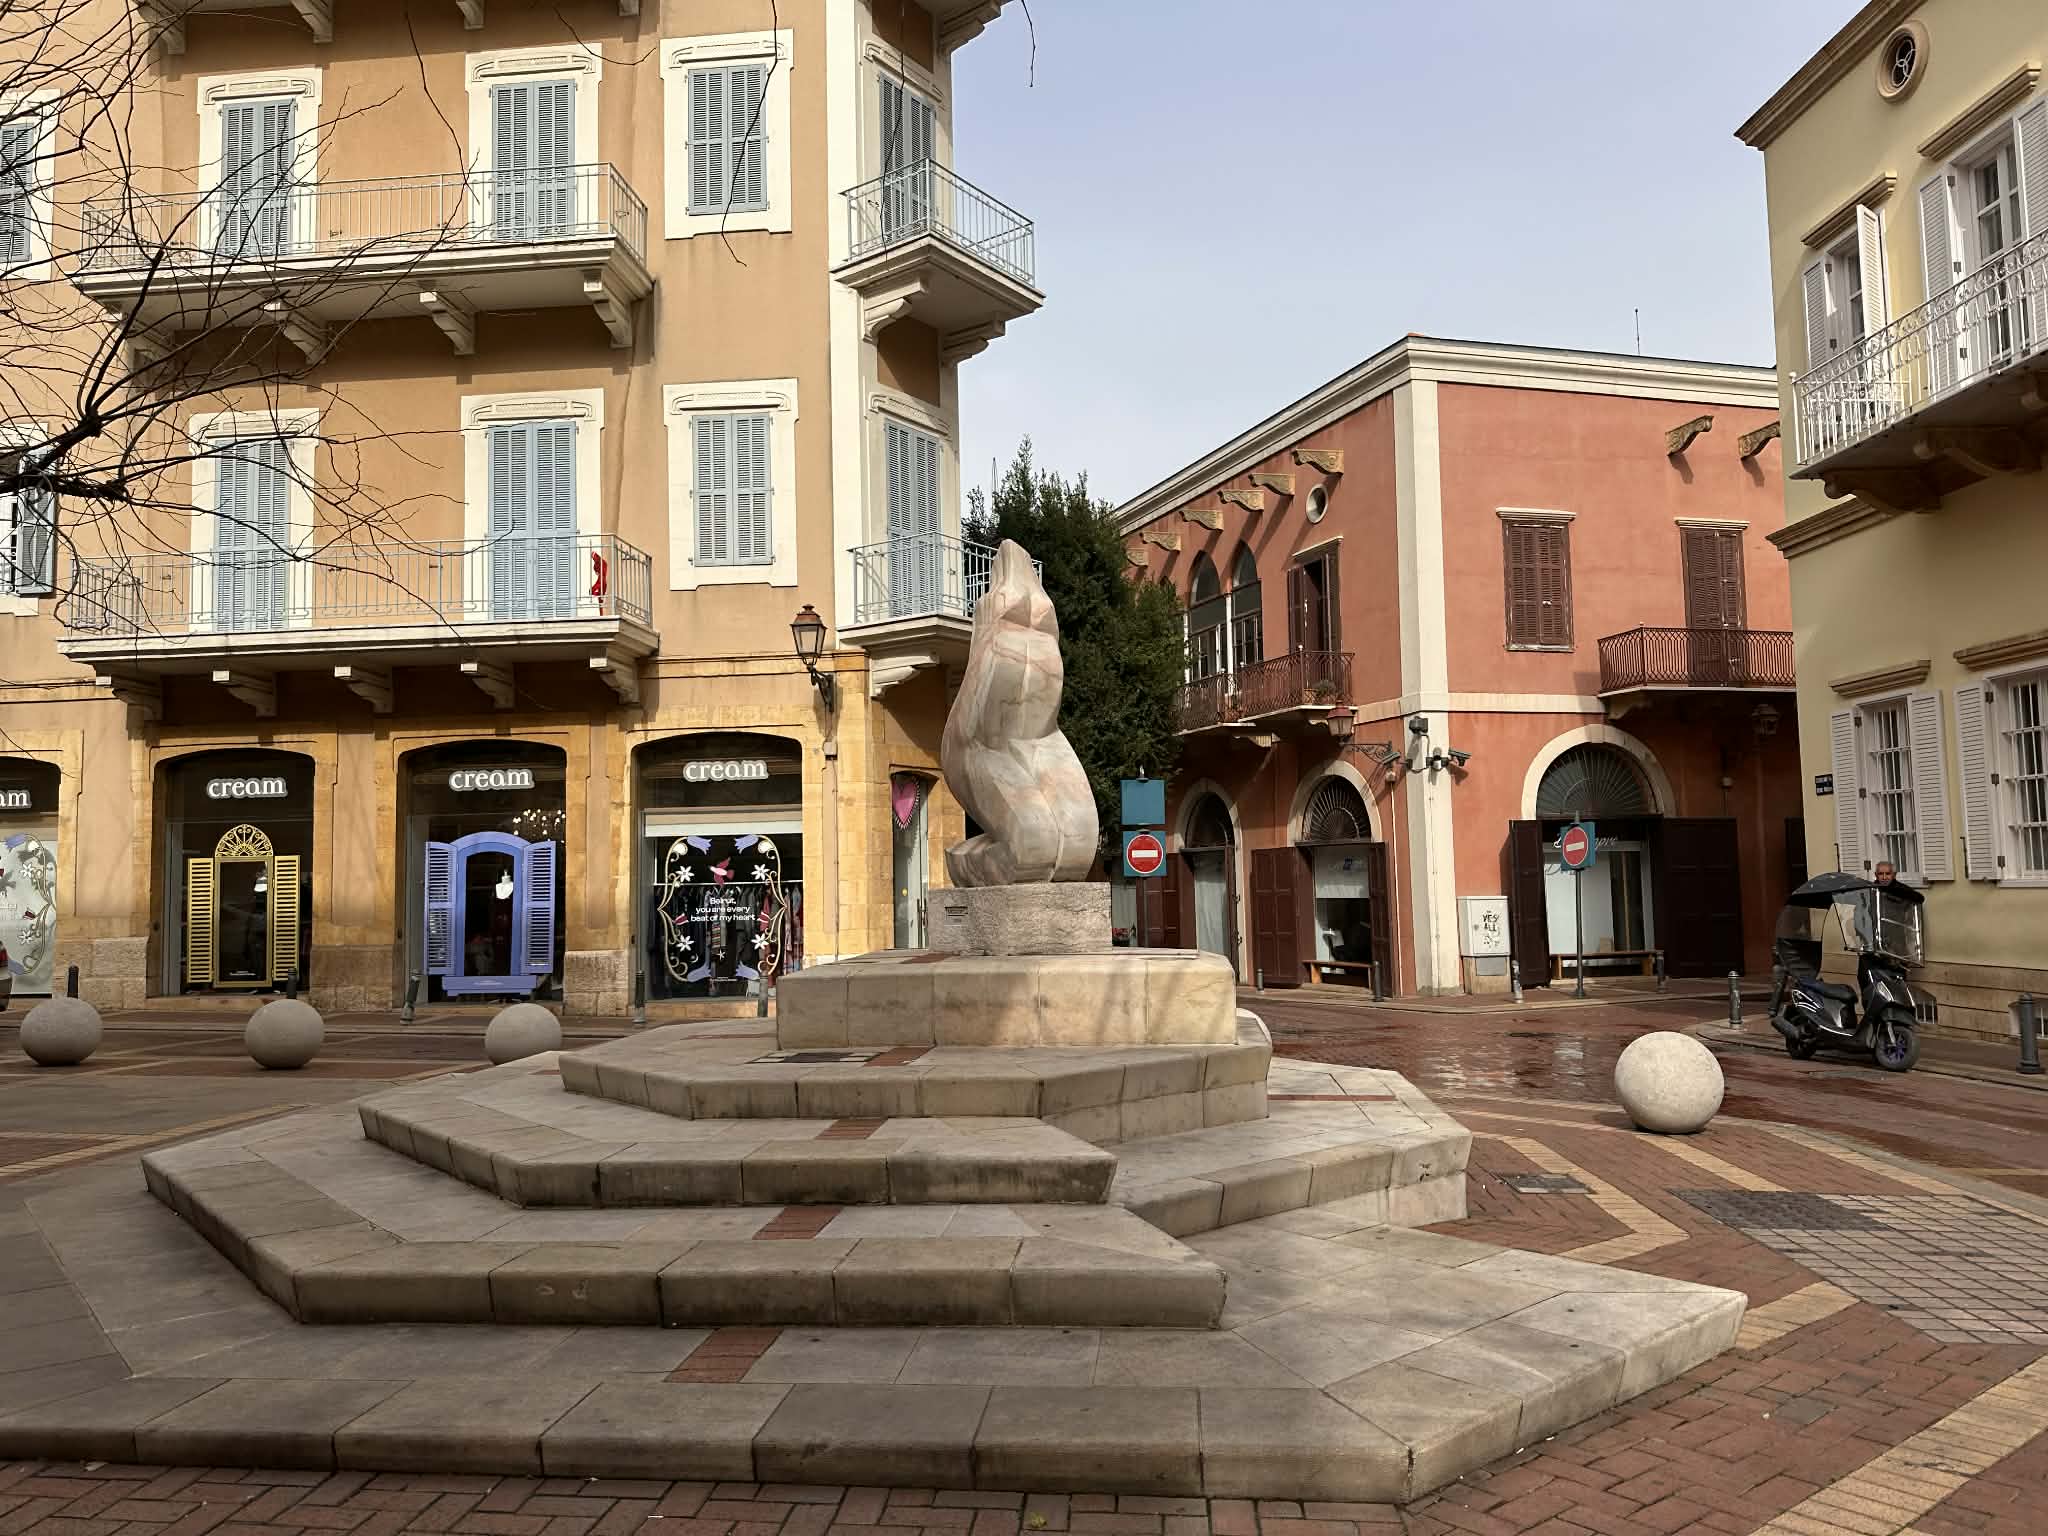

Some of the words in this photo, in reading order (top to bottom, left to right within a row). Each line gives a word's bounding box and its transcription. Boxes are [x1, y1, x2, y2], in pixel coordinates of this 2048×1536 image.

[450, 770, 533, 790] cream
[684, 762, 767, 780] cream
[208, 779, 286, 797] cream
[690, 914, 709, 922] beat
[720, 914, 732, 923] my
[733, 913, 756, 921] heart
[695, 907, 711, 915] you
[727, 906, 751, 914] every
